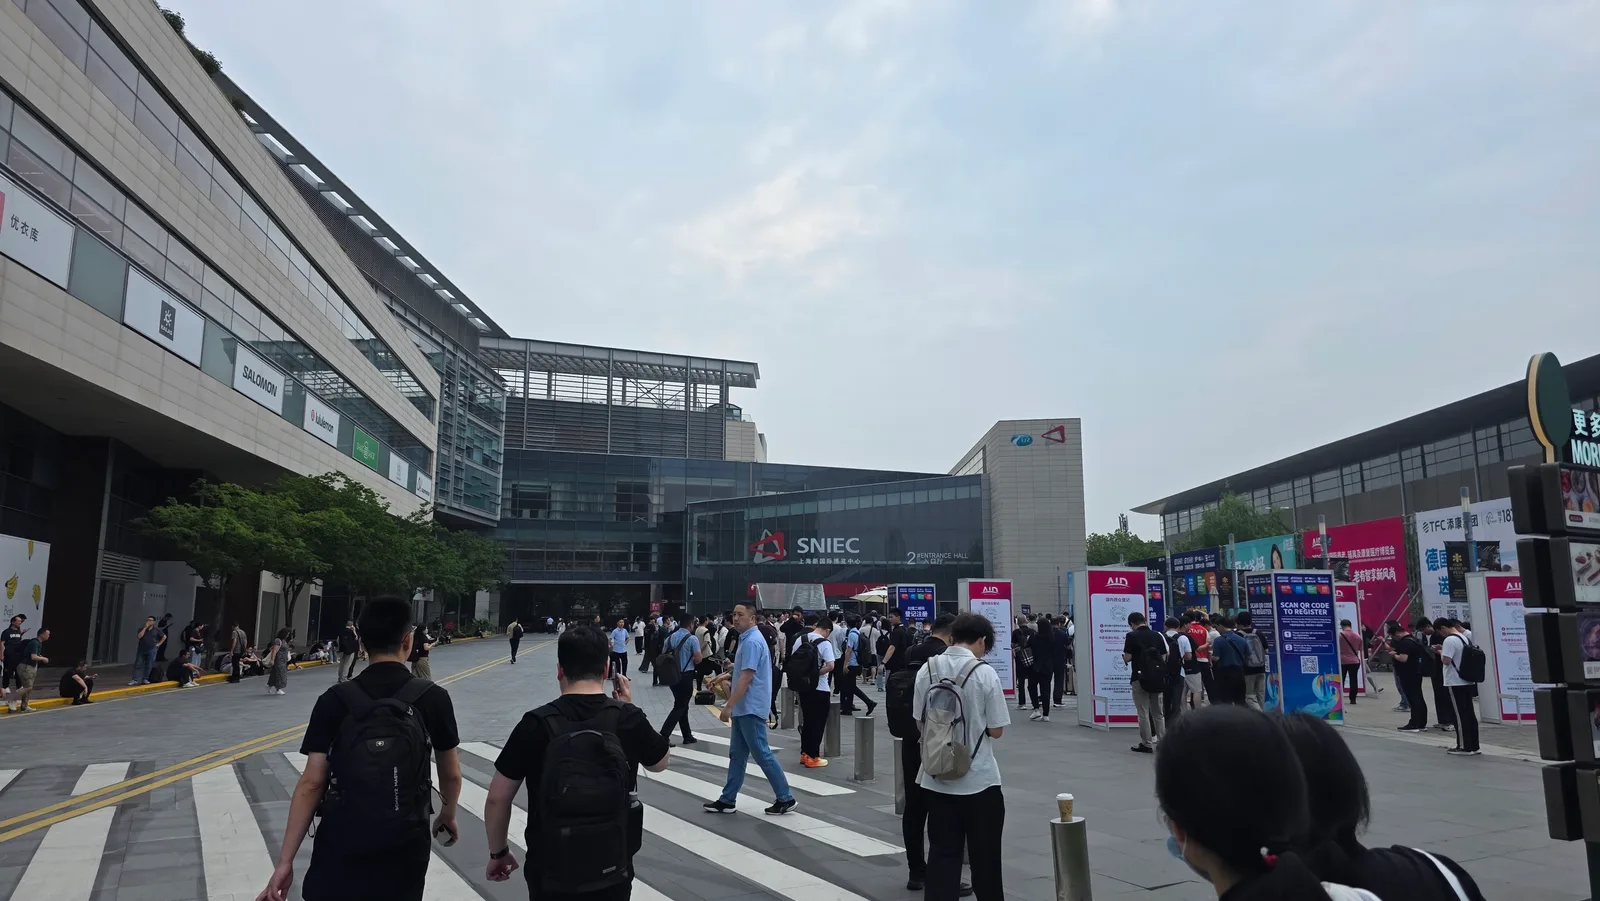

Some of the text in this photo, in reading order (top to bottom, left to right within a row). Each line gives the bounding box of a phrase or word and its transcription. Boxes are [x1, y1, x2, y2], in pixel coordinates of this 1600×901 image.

[11, 214, 39, 242] 优衣库
[242, 365, 278, 397] SALOMON
[1570, 438, 1600, 467] MOR
[1430, 514, 1478, 532] TFC 添康团
[797, 537, 860, 554] SNIEC
[1106, 577, 1128, 585] AID
